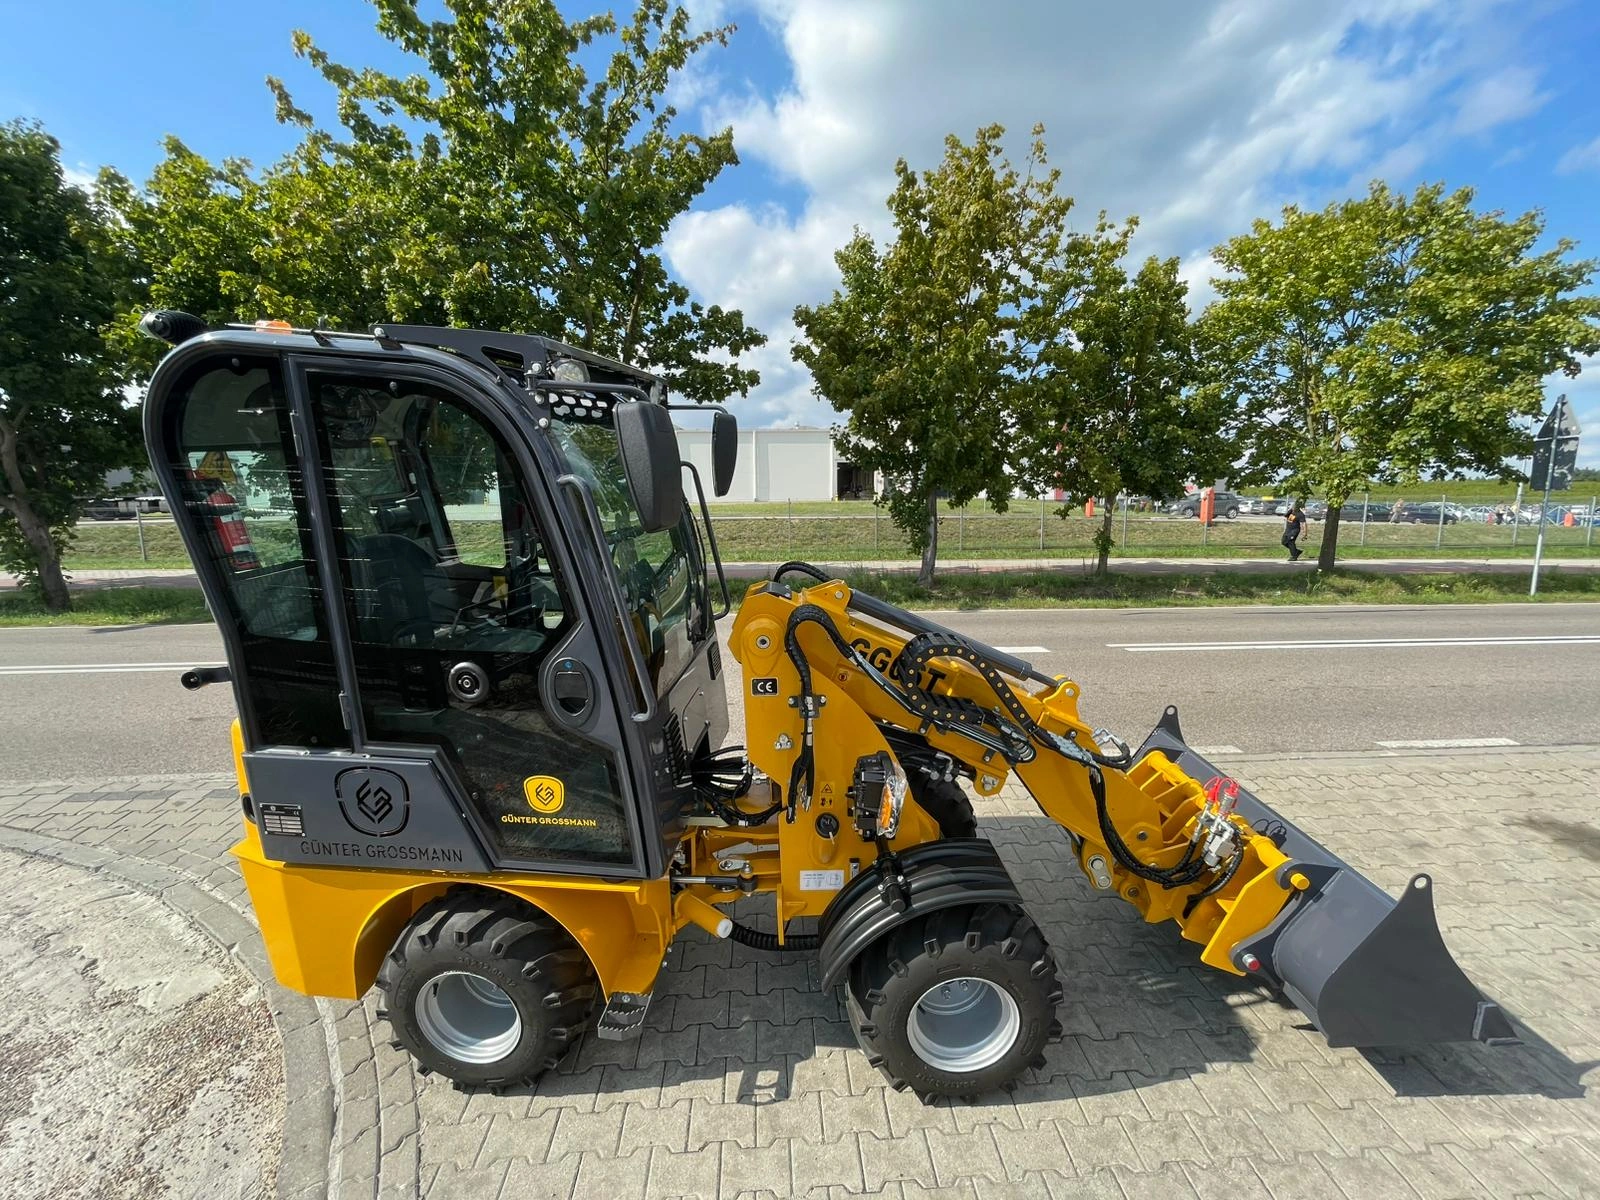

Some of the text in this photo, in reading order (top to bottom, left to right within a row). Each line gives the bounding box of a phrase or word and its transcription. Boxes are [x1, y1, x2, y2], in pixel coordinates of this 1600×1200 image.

[757, 681, 773, 693] CE
[501, 814, 597, 827] GÜNTER GROSSMANN
[300, 840, 463, 863] GÜNTER GROSSMANN
